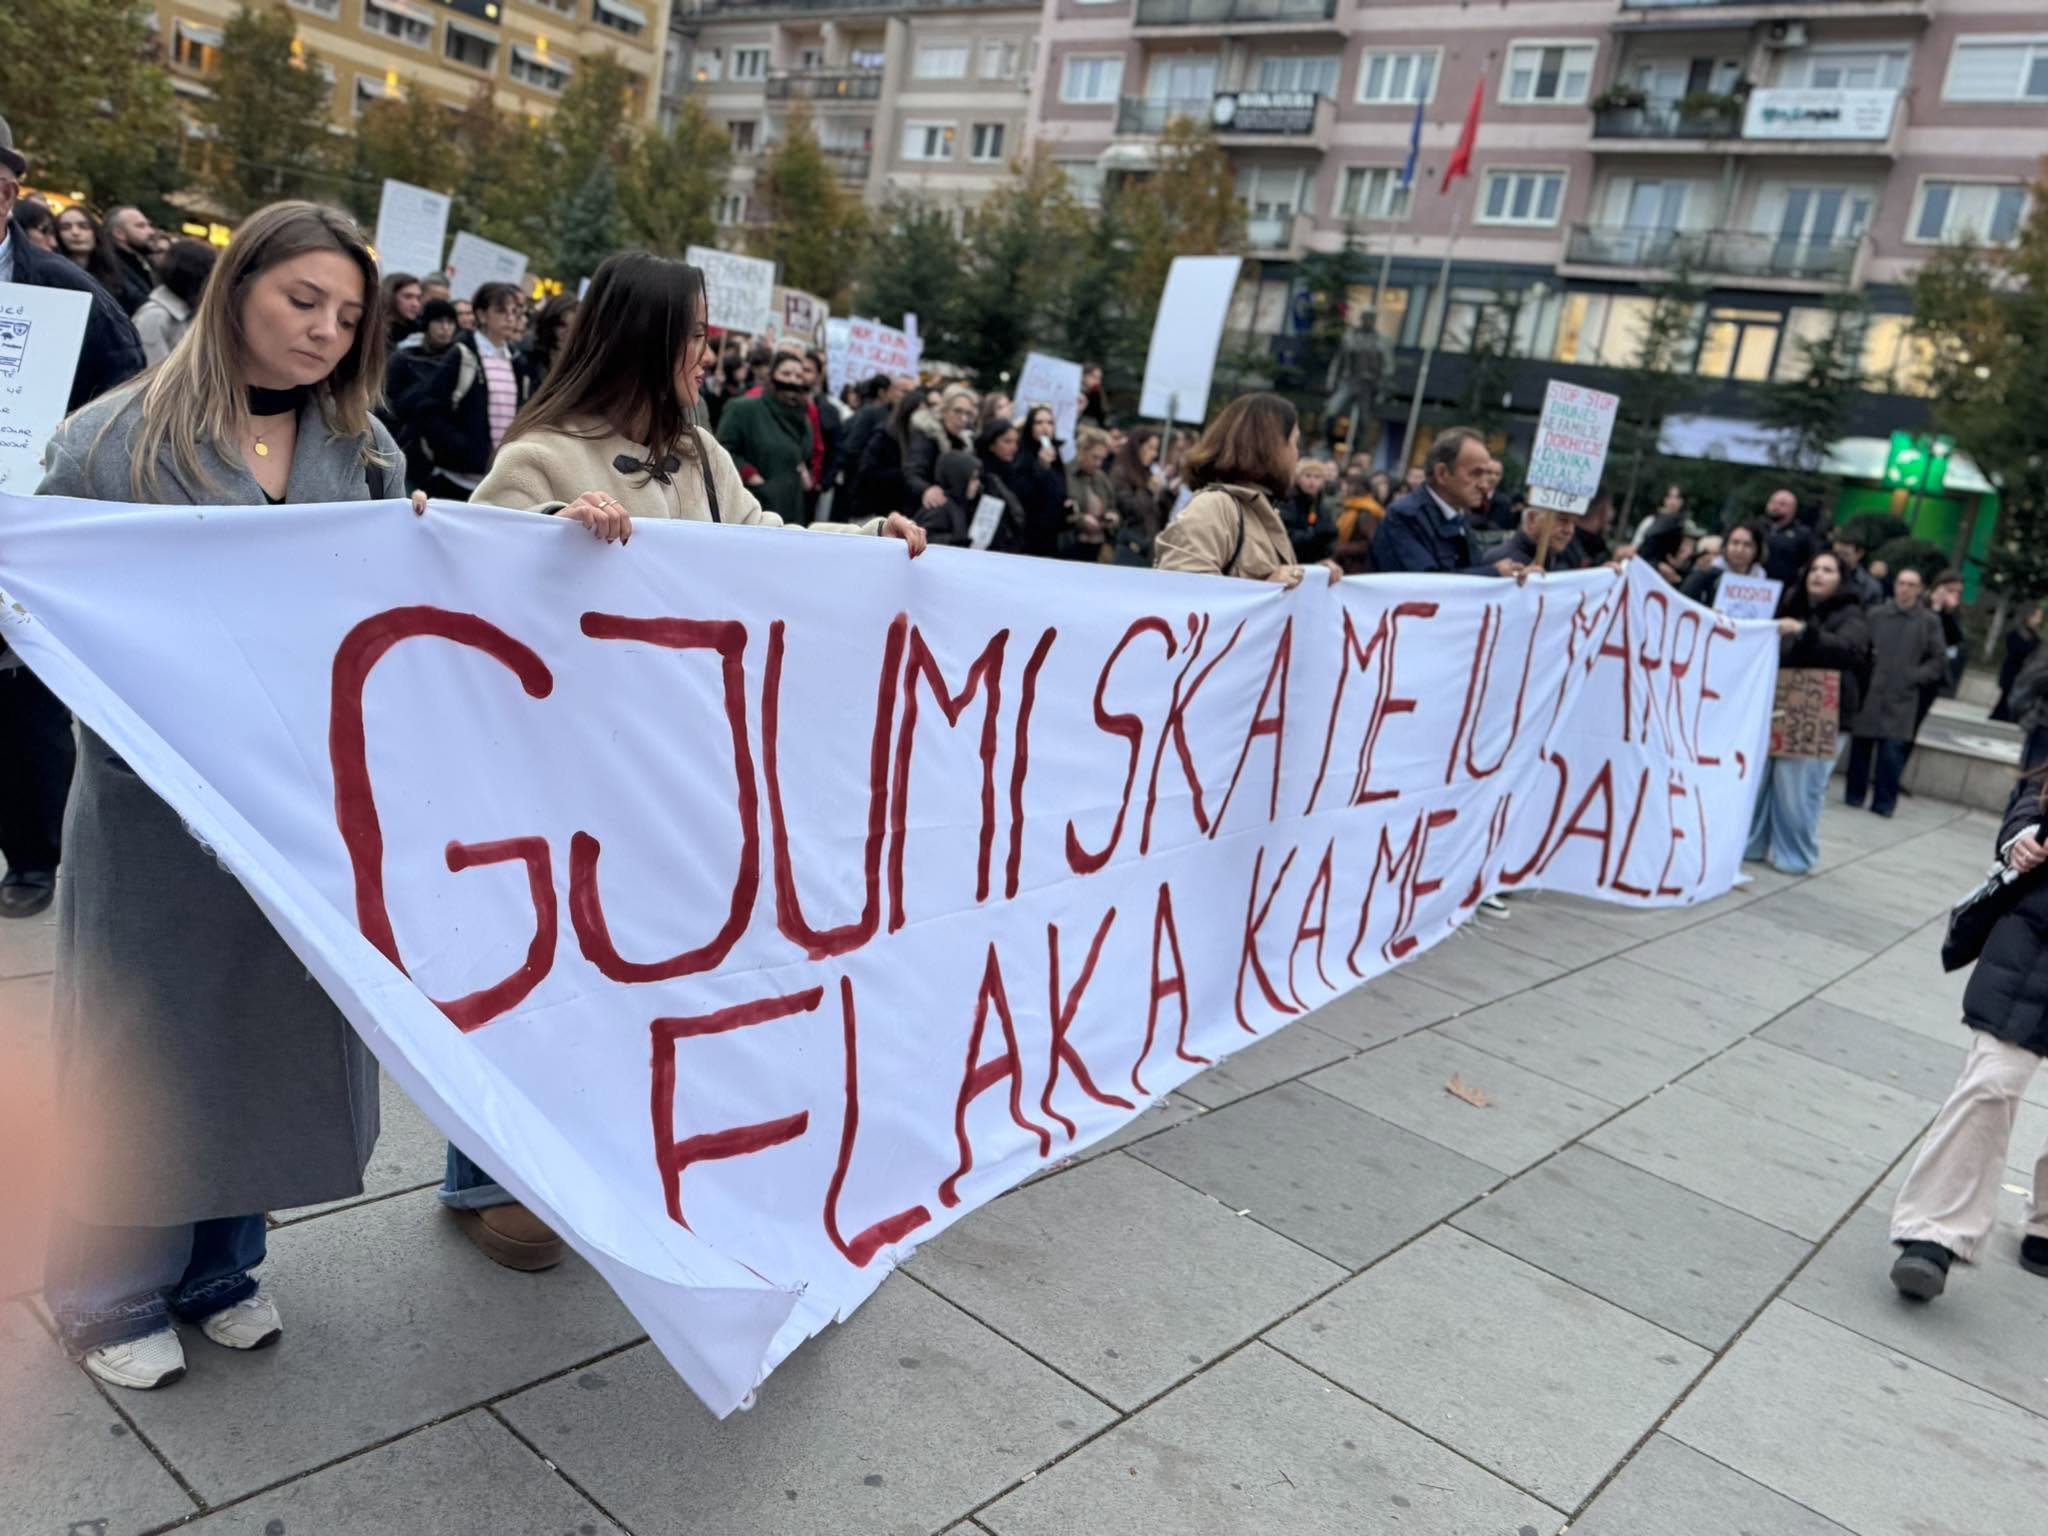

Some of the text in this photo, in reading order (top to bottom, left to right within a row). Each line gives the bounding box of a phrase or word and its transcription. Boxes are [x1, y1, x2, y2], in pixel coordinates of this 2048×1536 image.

[1539, 487, 1579, 508] STOP
[329, 604, 1057, 1033] GJUMI
[1304, 602, 1439, 815] ME
[1445, 595, 1543, 784] IU
[650, 882, 1213, 1267] FLAKA
[1236, 838, 1338, 1035] KA
[1346, 806, 1457, 978] ME
